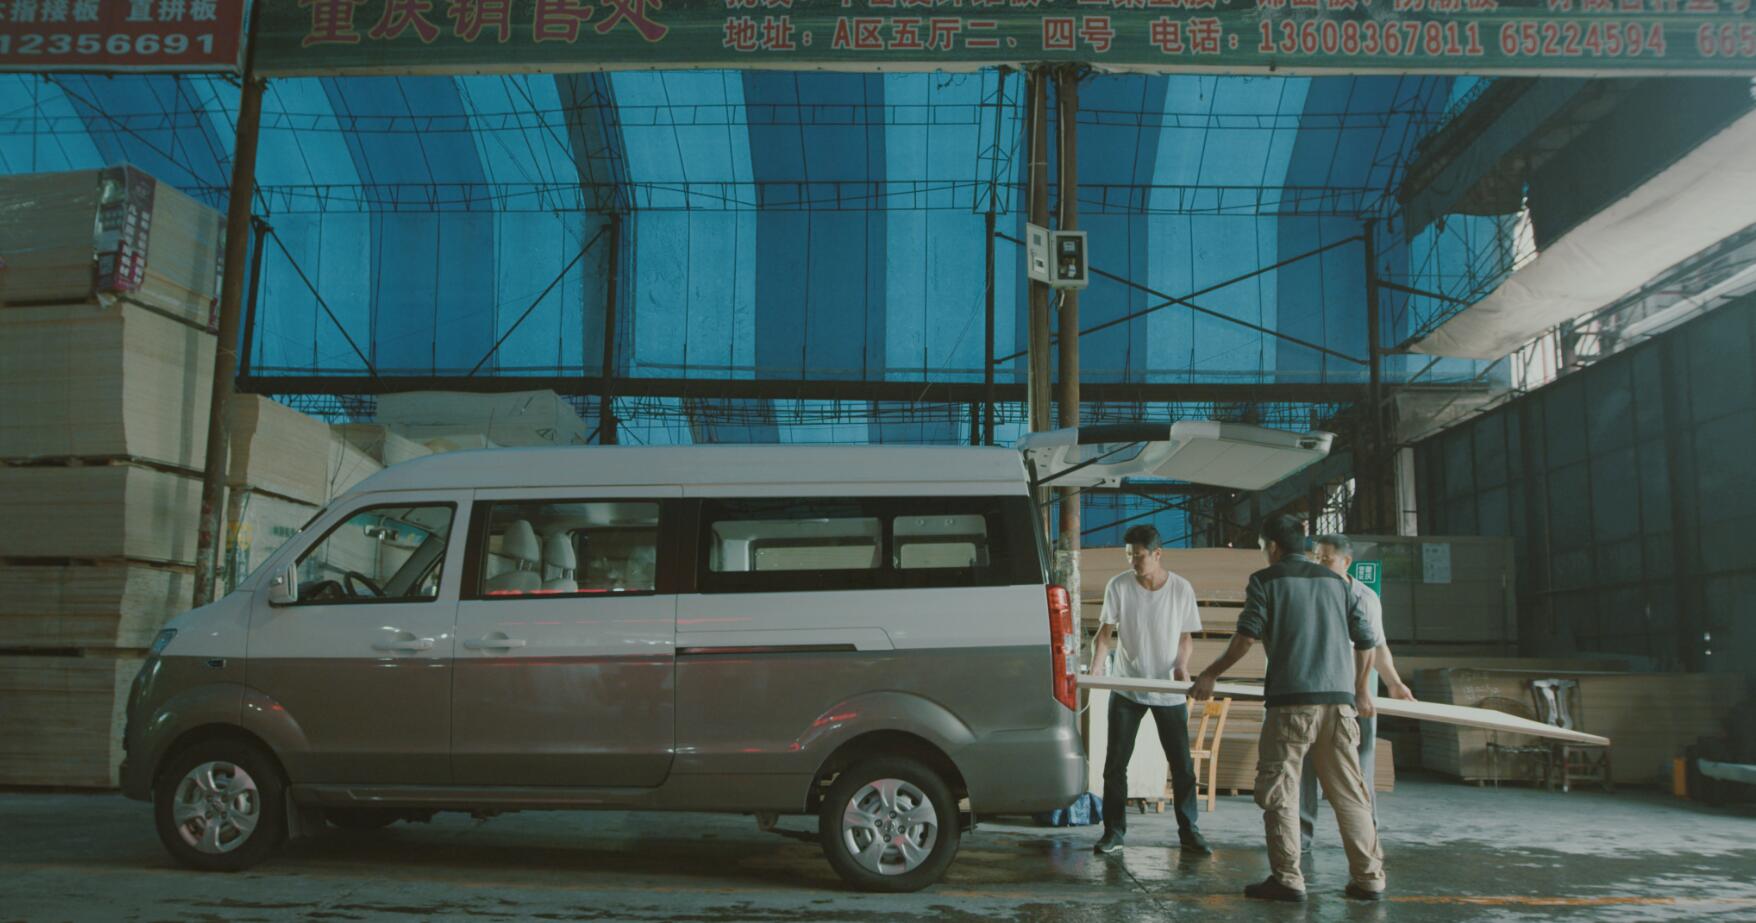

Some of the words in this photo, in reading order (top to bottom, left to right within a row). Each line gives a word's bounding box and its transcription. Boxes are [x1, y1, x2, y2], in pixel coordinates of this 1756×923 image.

[0, 0, 99, 22] 指接板
[125, 0, 217, 22] 直拼板
[0, 33, 215, 55] 12356691
[1499, 21, 1666, 57] 65224594
